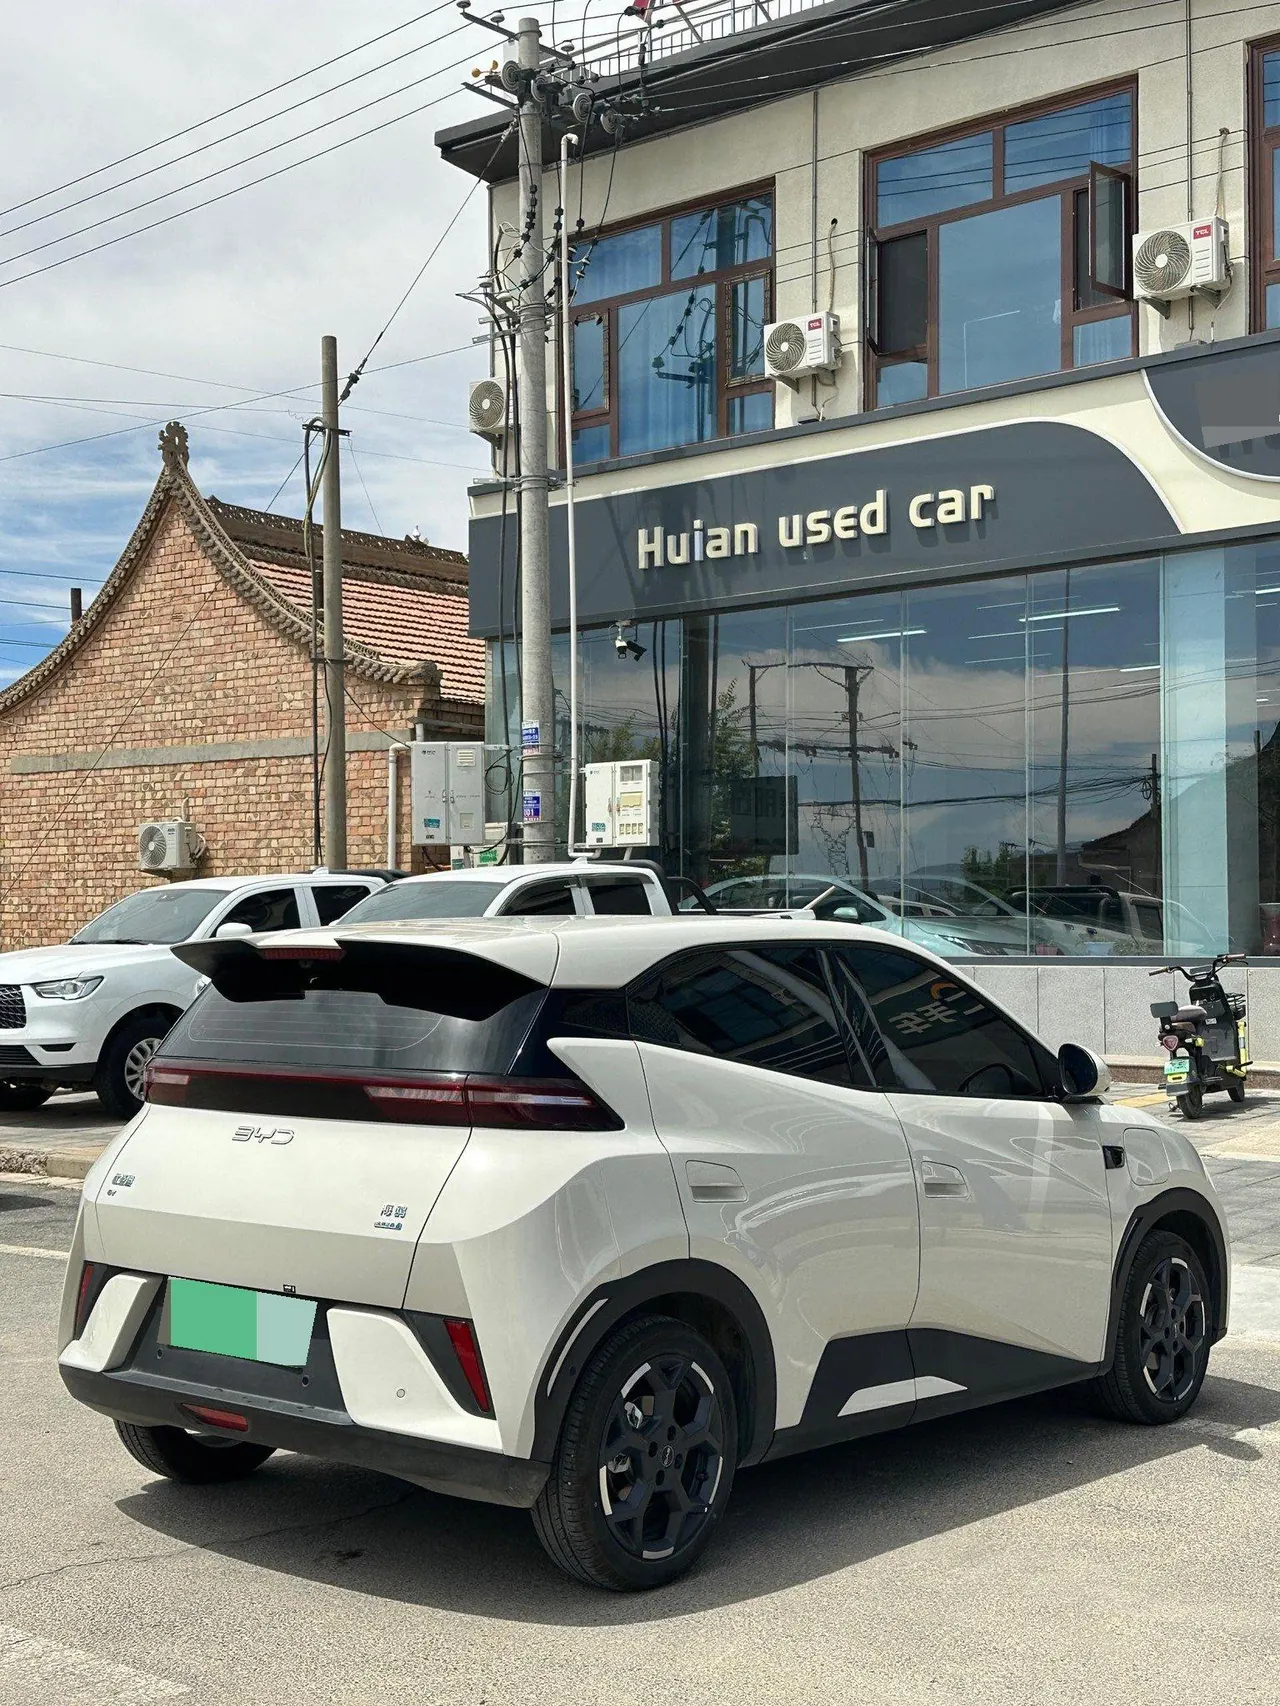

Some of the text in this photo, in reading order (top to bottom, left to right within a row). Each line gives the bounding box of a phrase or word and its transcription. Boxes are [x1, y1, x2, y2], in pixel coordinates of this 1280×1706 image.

[1195, 228, 1210, 236] TCL
[637, 484, 995, 570] Huian used car
[231, 1125, 295, 1145] BYD
